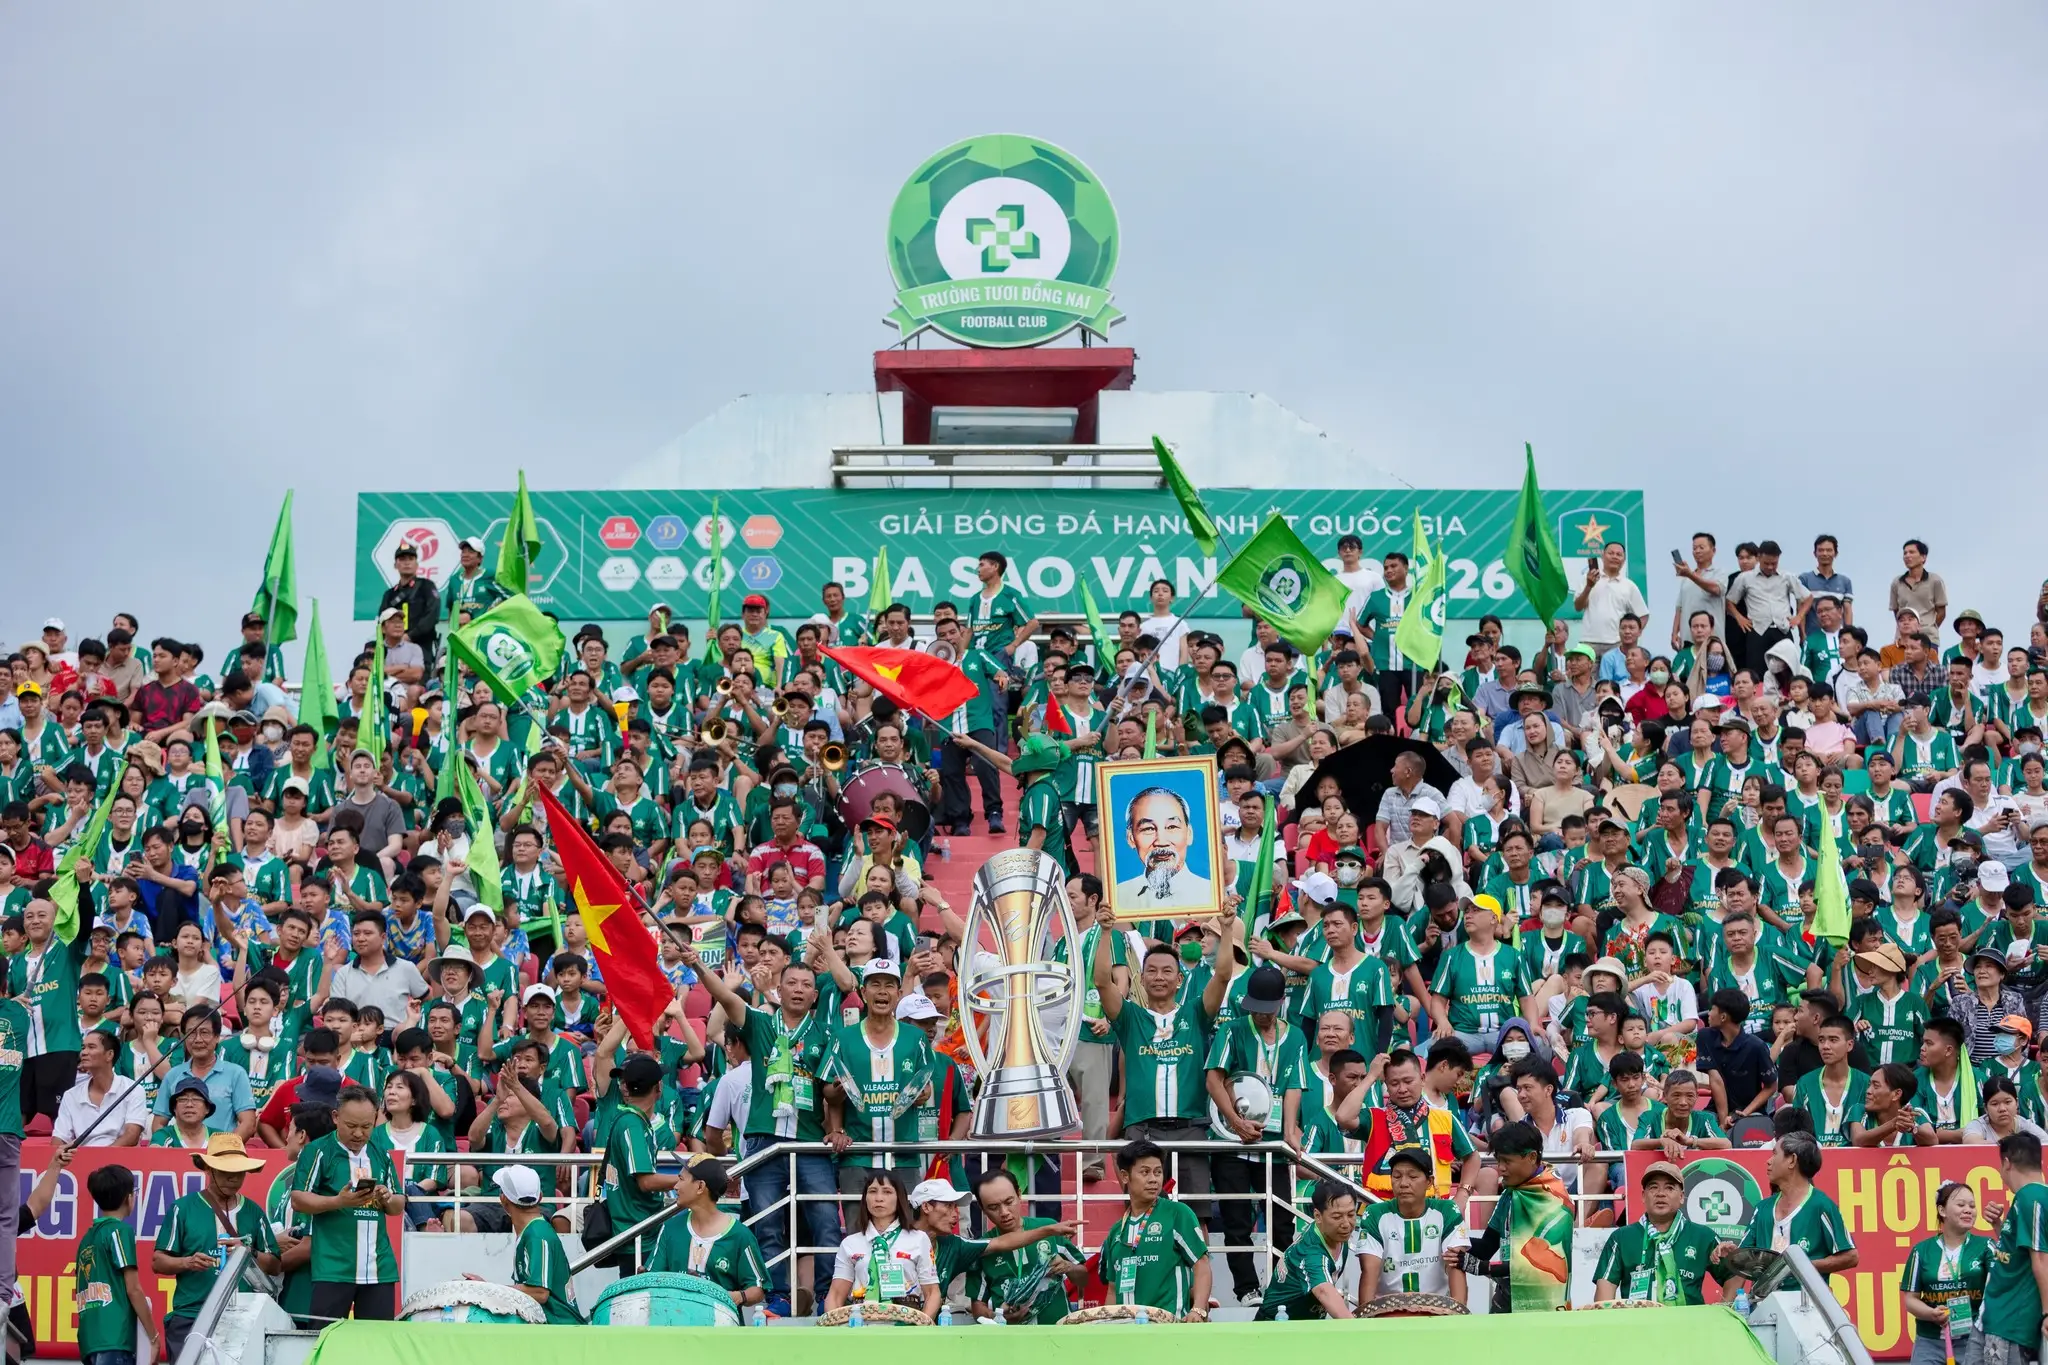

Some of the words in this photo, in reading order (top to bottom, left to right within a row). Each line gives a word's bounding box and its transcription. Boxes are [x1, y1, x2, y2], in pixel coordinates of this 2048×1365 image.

[919, 285, 980, 310] TRƯỜNG
[984, 286, 1019, 302] TƯƠI
[1022, 281, 1062, 304] ĐỒNG
[1066, 292, 1091, 310] NAI
[961, 315, 1015, 328] FOOTBALL
[1018, 315, 1048, 328] CLUB
[879, 507, 942, 535] GIẢI
[954, 509, 1046, 535] BÓNG
[1056, 509, 1103, 535] ĐÁ
[1309, 507, 1402, 536] QUỐC
[1460, 993, 1511, 1005] CHAMPIONS
[1838, 1153, 1942, 1247] HỘI
